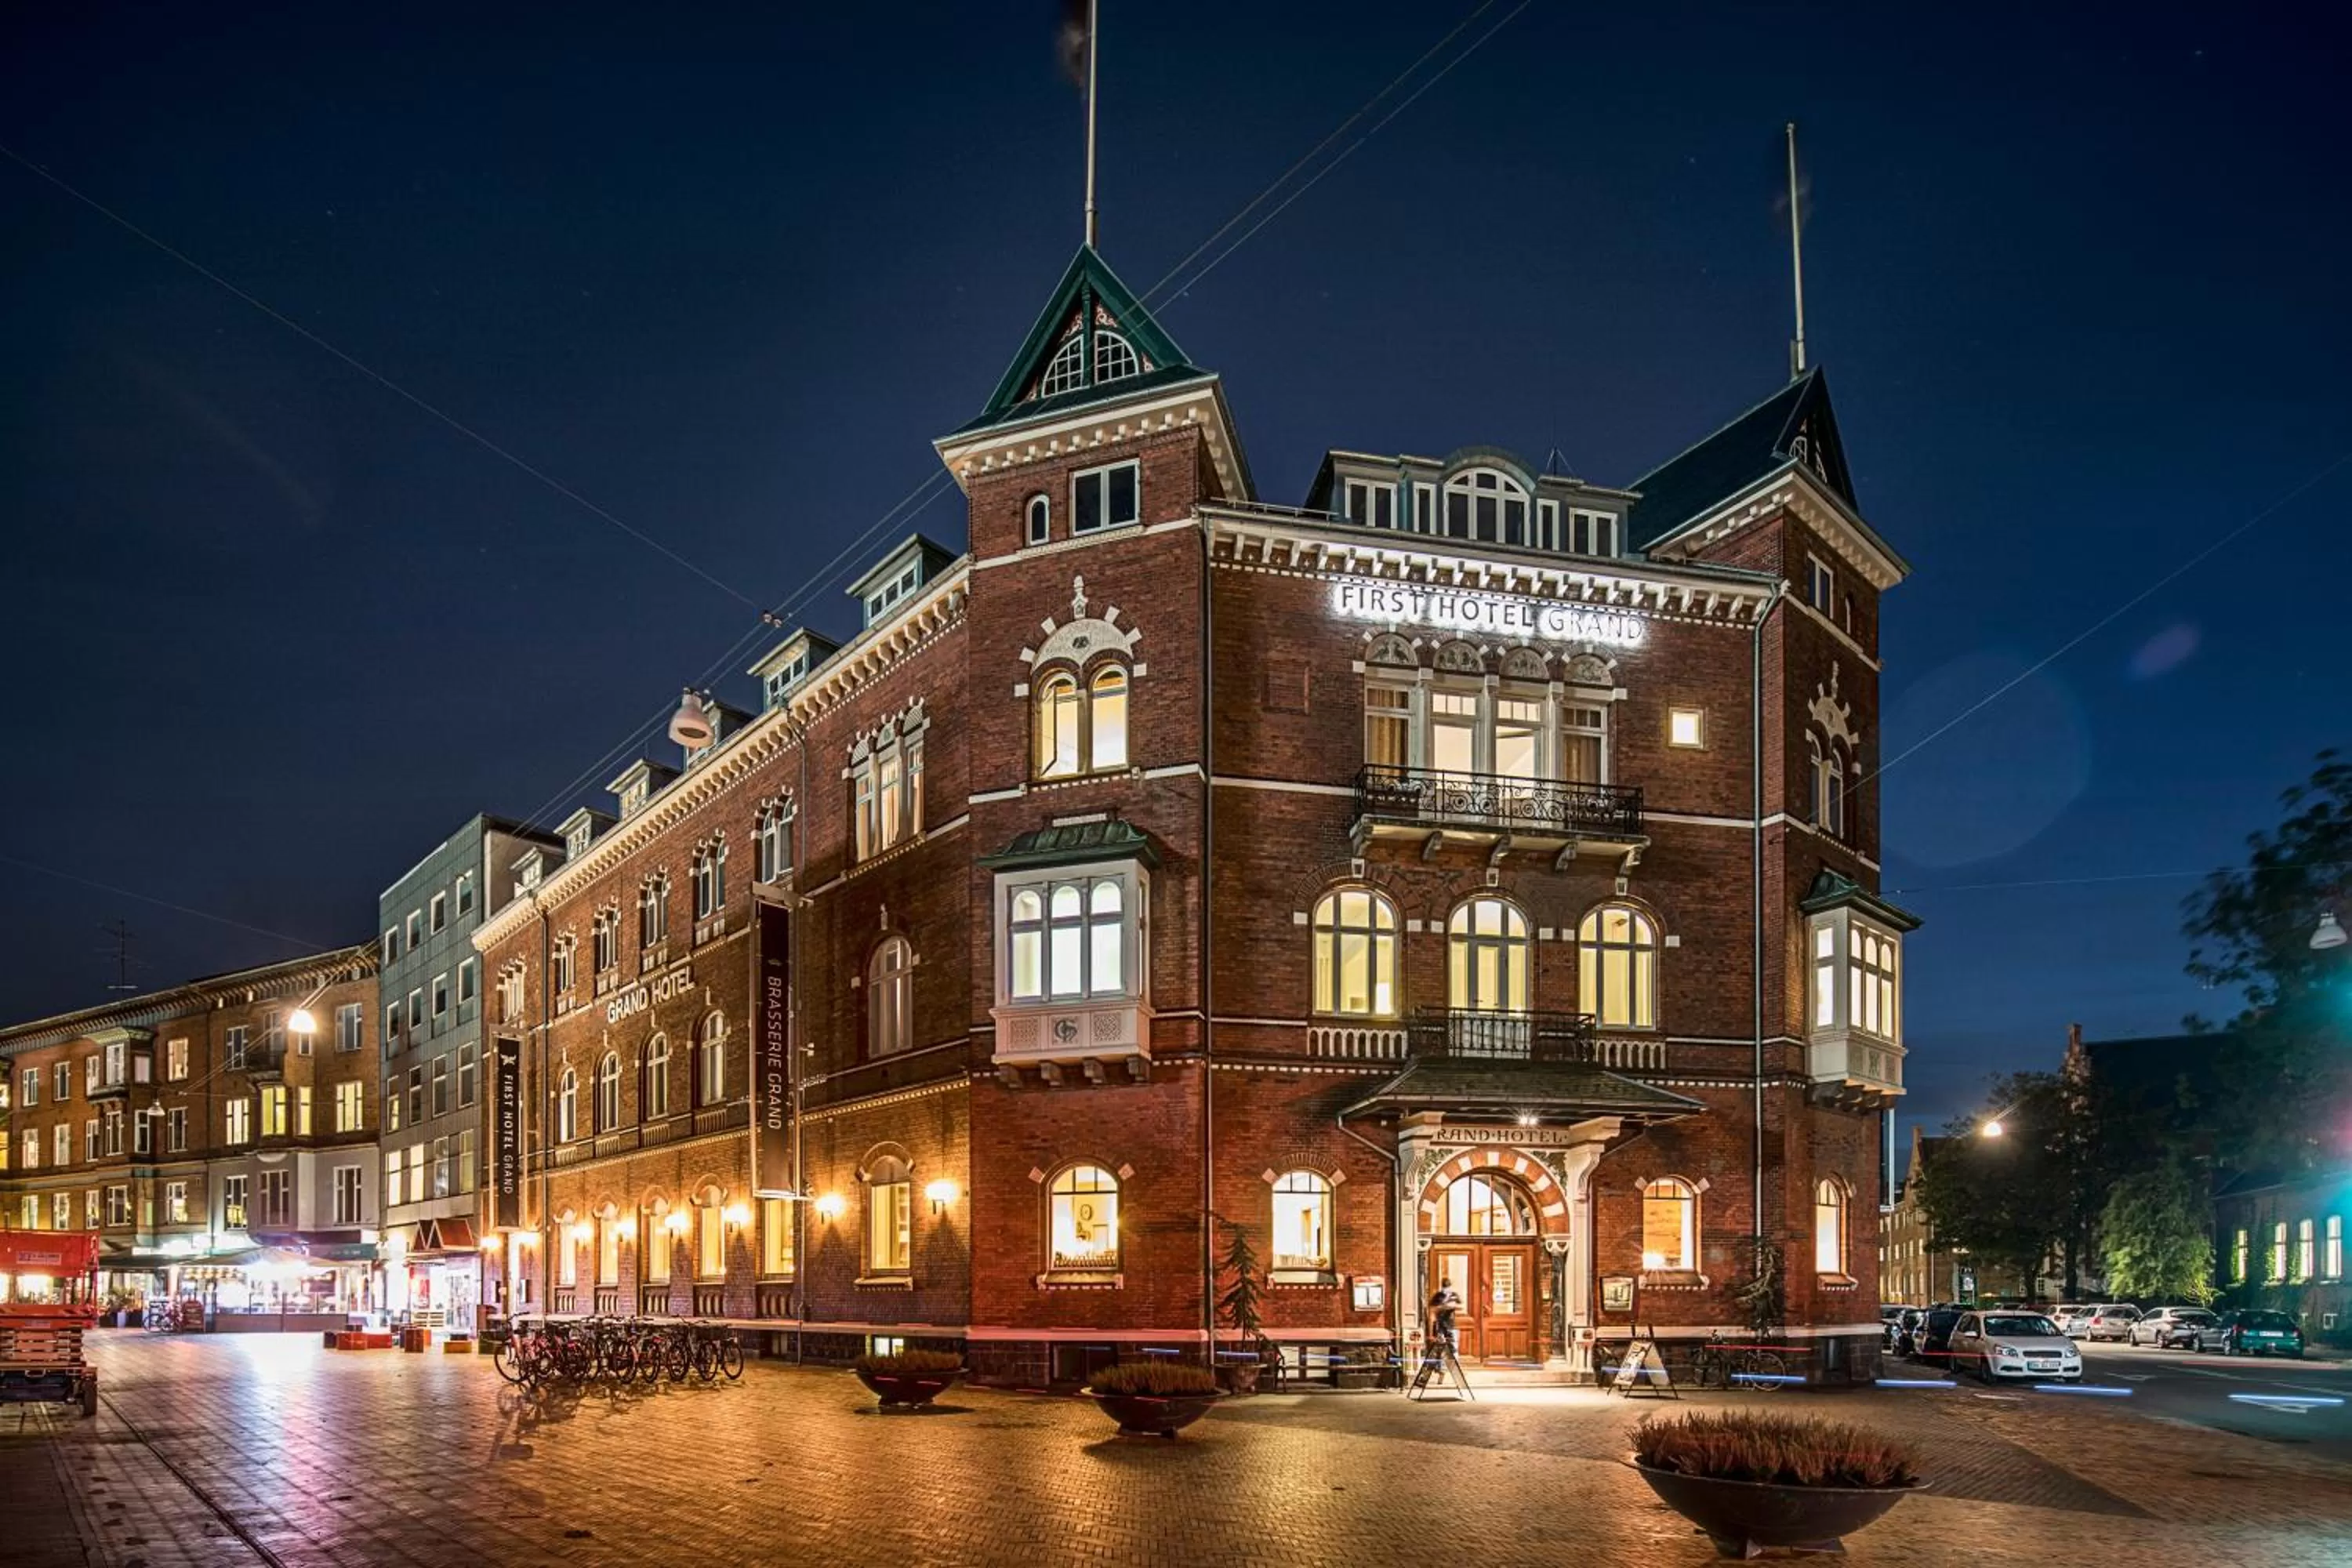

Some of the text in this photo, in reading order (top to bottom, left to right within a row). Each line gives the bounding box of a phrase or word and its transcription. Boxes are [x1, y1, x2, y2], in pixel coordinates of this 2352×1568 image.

[1342, 586, 1643, 639] FIRST HOTEL GRAND
[608, 965, 696, 1024] GRAND HOTEL
[767, 975, 782, 1130] BRASSERIE GRAND
[503, 1074, 514, 1194] FIRST HOTEL GRAND
